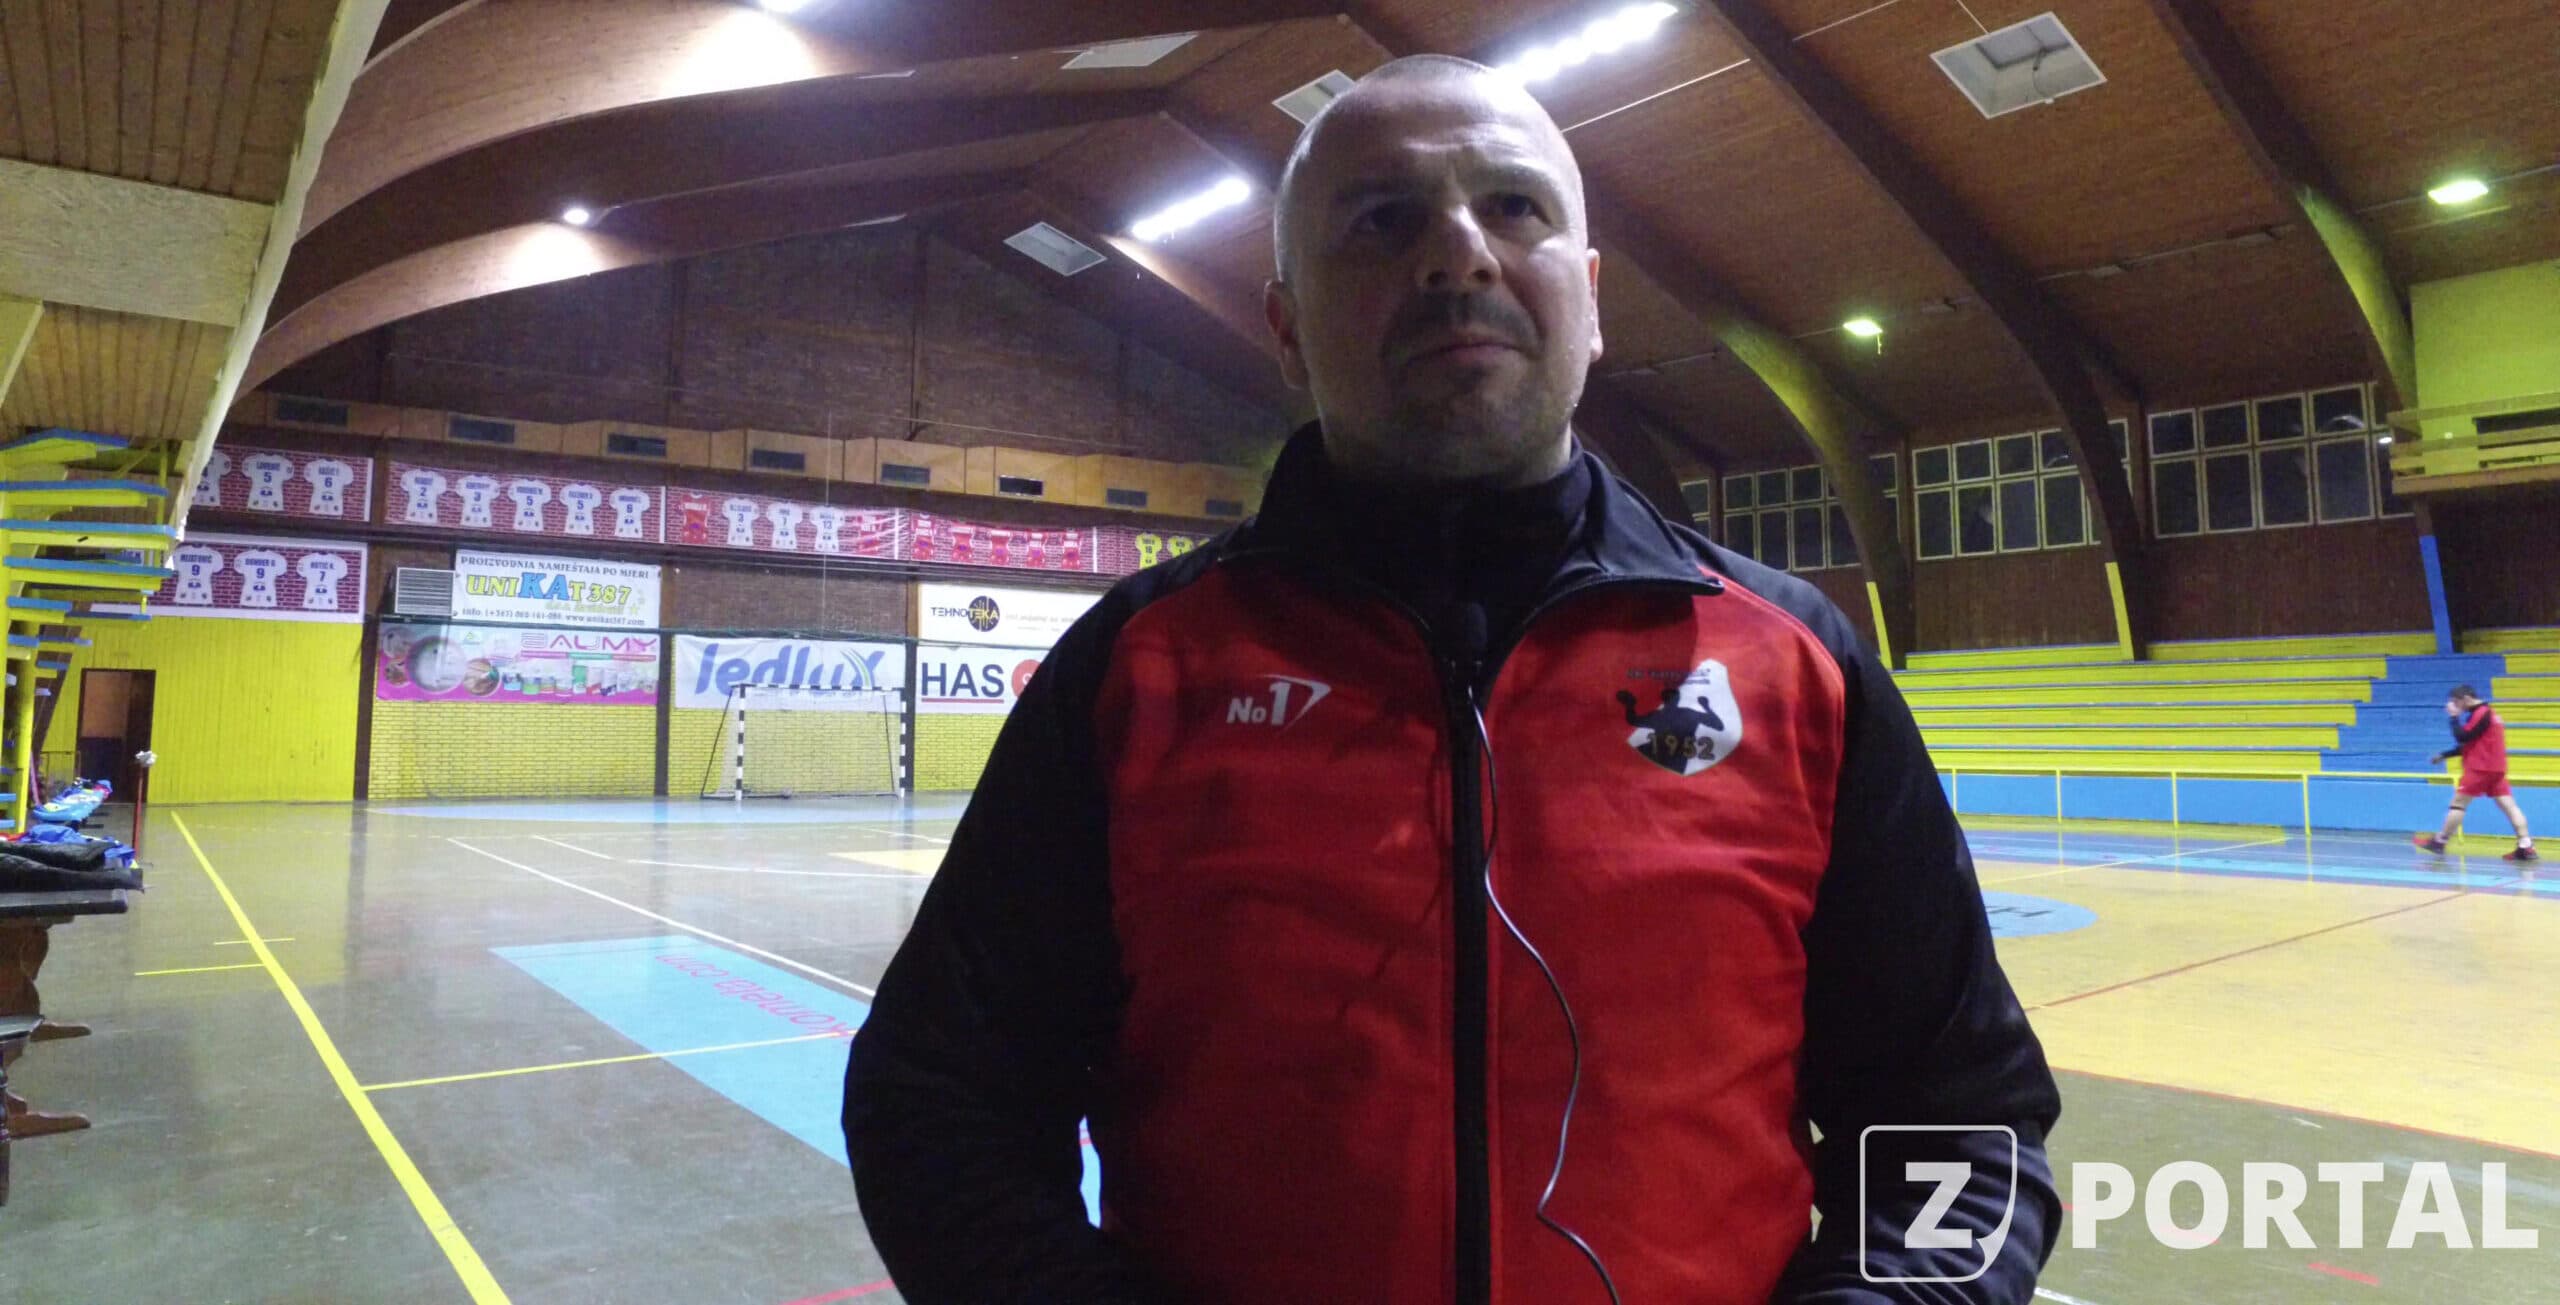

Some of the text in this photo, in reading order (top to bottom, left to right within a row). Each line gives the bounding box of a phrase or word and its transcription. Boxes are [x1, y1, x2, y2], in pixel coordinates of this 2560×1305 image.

[191, 564, 200, 576] 9
[256, 567, 265, 579] 9
[602, 567, 617, 576] PO
[921, 662, 1005, 698] HAS
[1646, 731, 1716, 761] 1952
